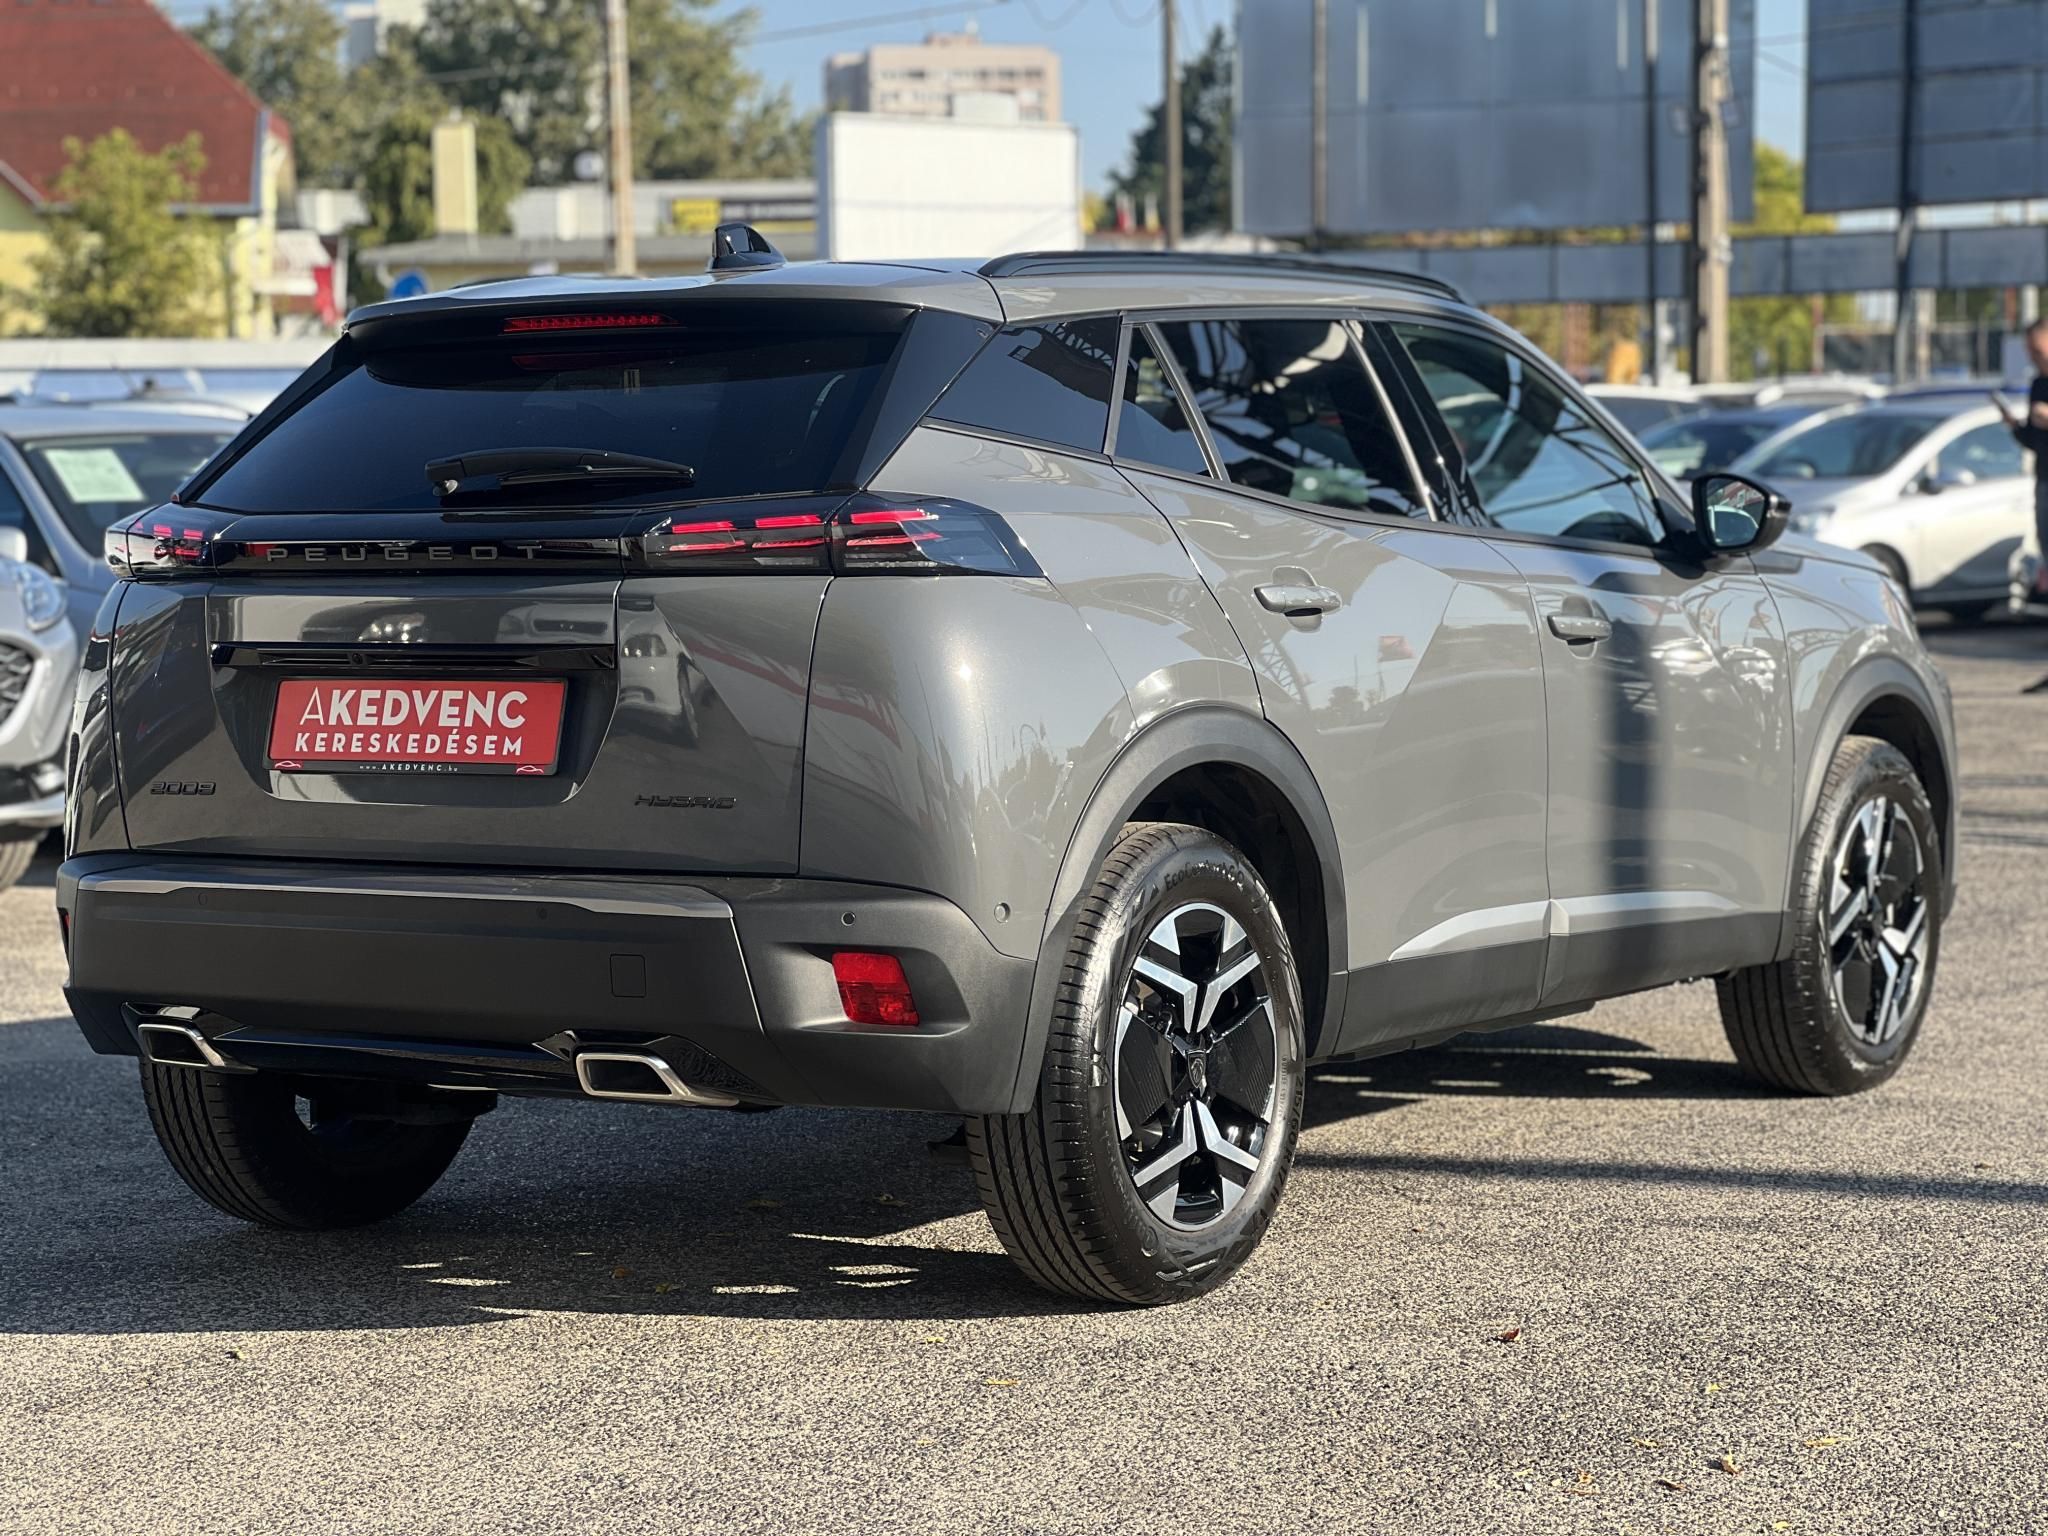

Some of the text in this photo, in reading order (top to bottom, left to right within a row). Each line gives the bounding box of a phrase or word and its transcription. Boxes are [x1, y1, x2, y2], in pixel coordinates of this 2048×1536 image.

[266, 545, 542, 562] PEUGEOT
[299, 686, 528, 729] AKEDVENC
[295, 729, 522, 756] KERESKEDÉSEM
[634, 795, 737, 809] HYBRID
